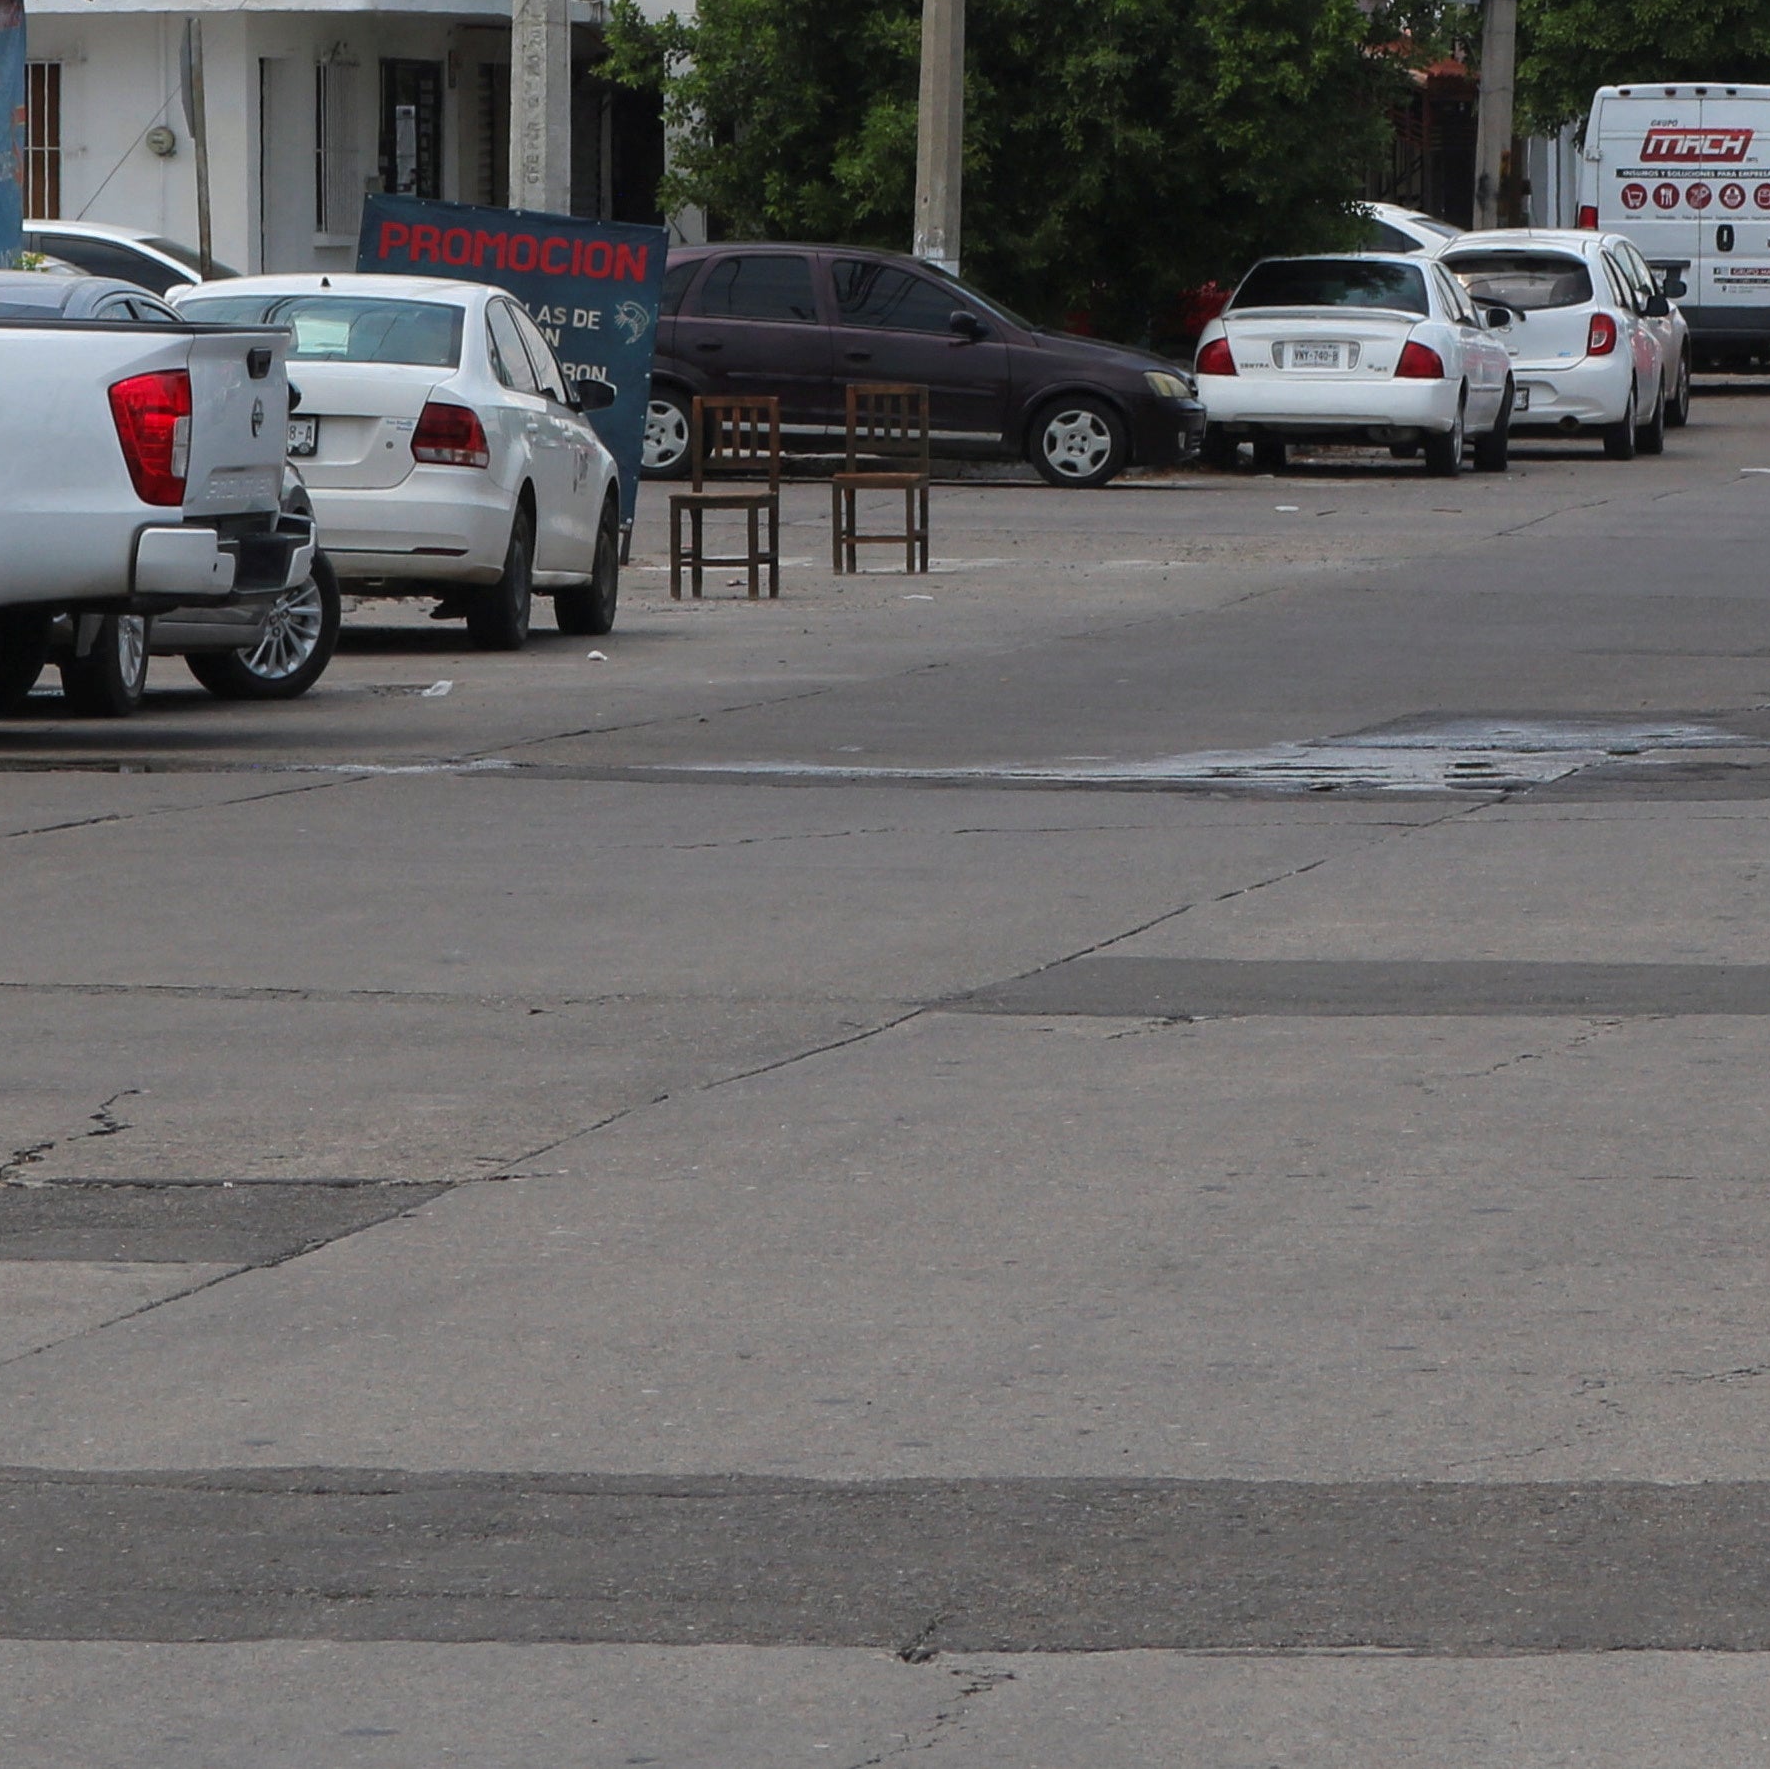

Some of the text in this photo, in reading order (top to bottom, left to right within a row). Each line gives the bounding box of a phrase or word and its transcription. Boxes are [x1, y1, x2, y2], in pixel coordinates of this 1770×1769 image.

[1650, 119, 1678, 127] GRUPO
[1645, 133, 1746, 156] MACH
[1661, 170, 1666, 178] Y
[1667, 170, 1716, 178] SOLUCIONES
[1717, 170, 1737, 178] PARA
[377, 221, 649, 283] PROMOCION
[572, 309, 601, 330] DE
